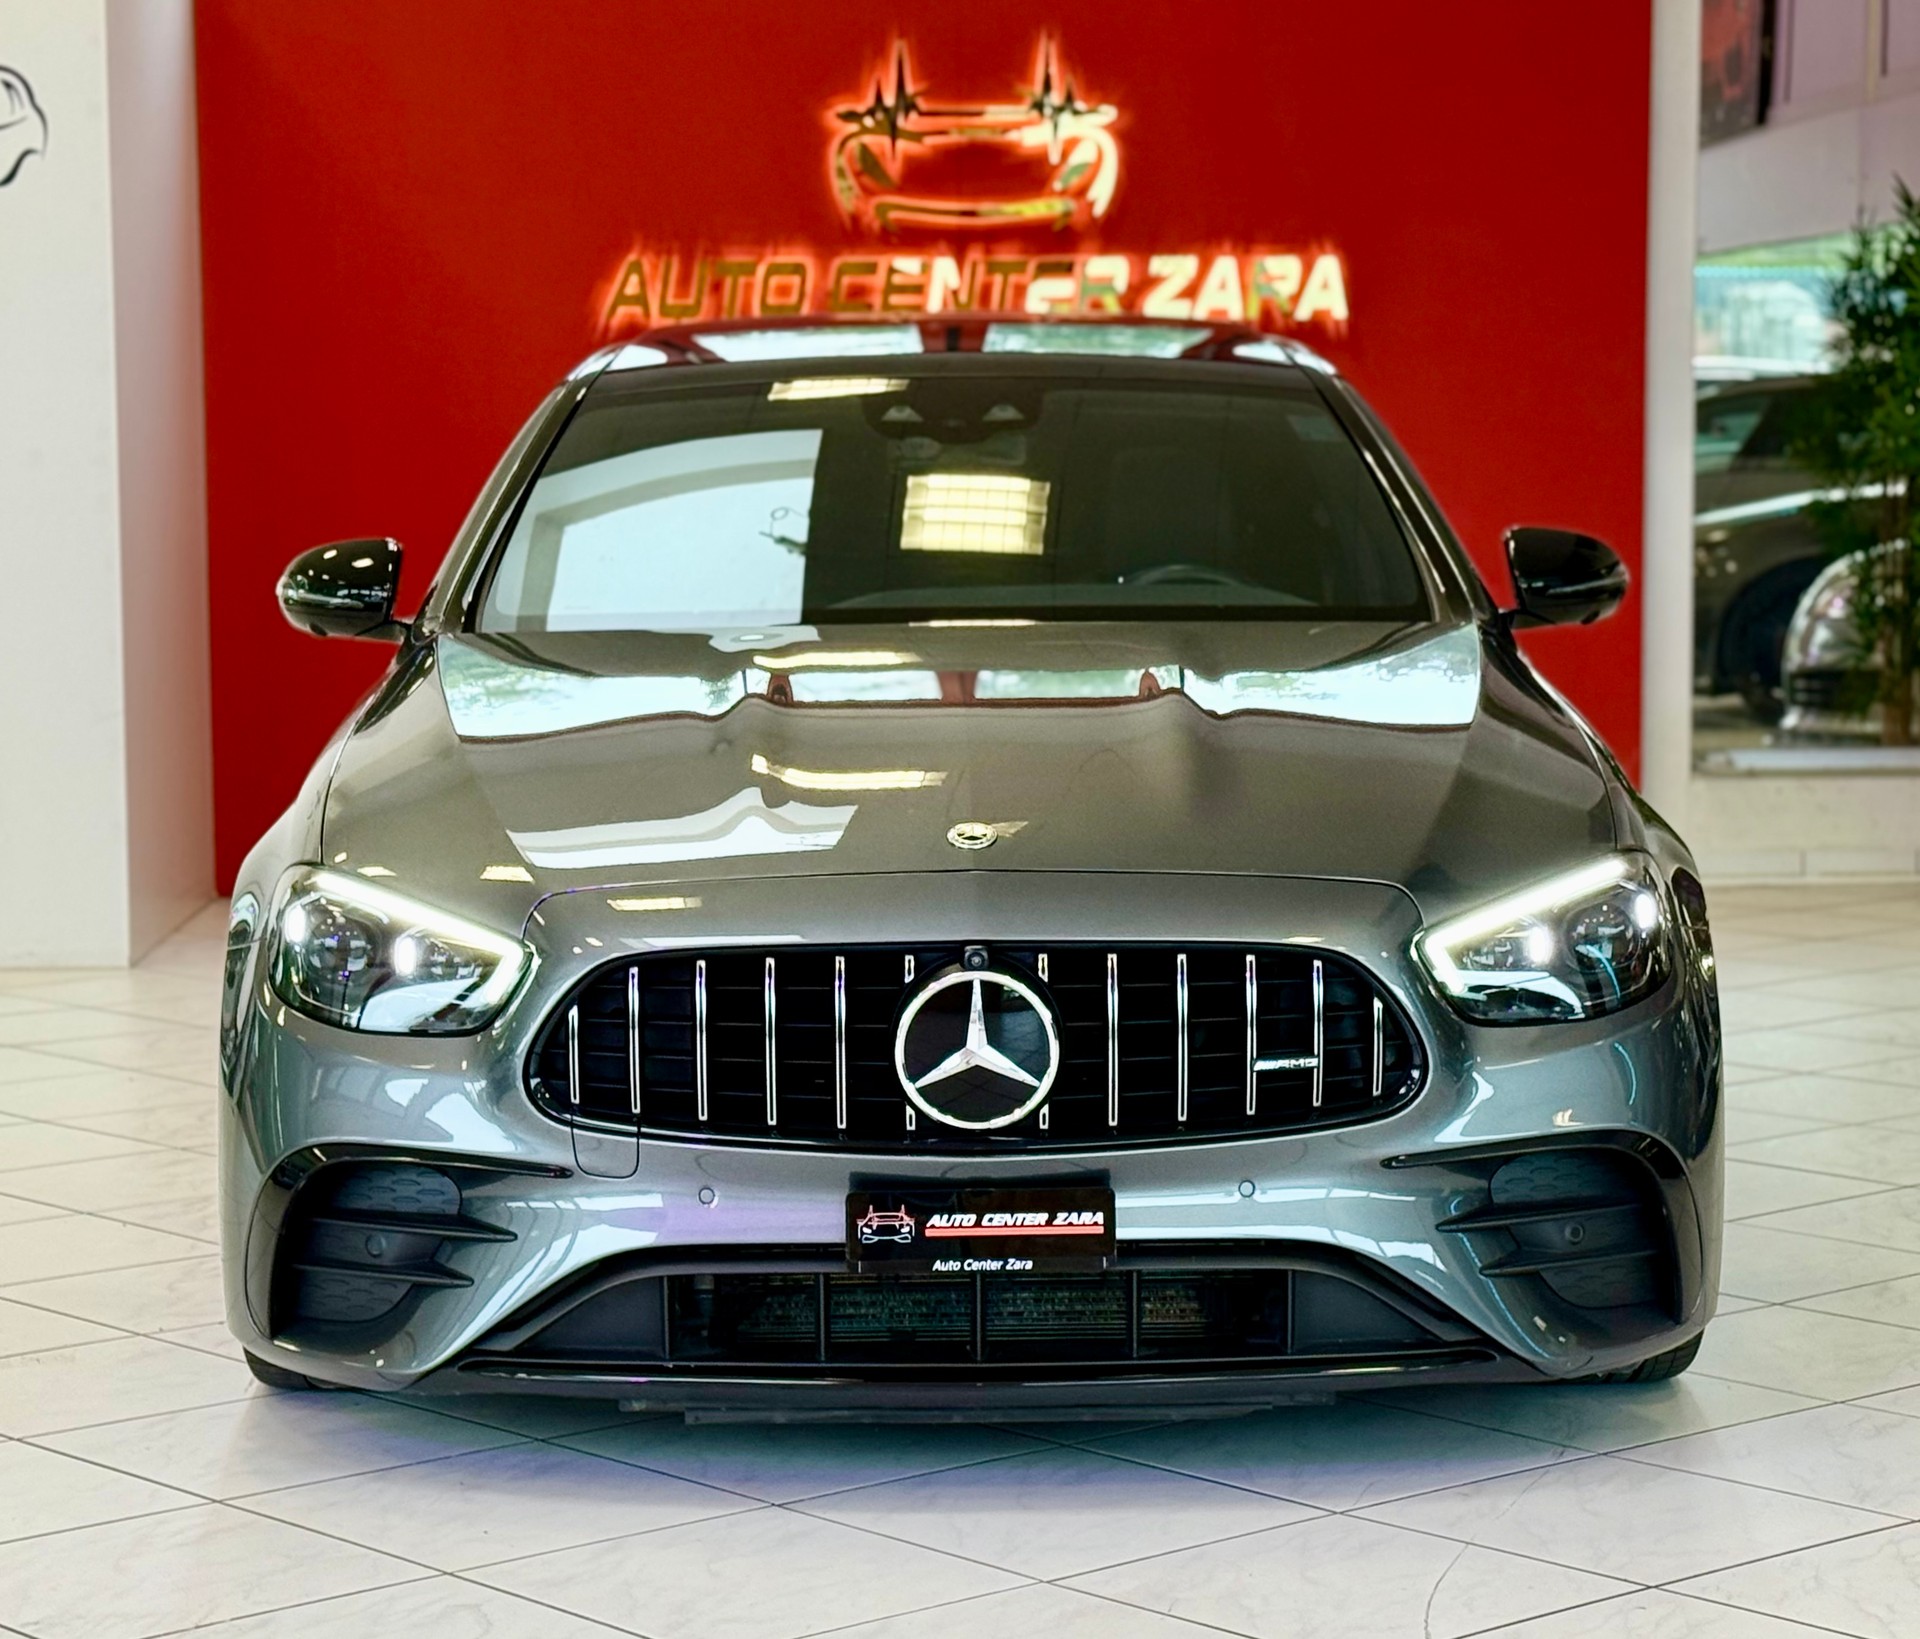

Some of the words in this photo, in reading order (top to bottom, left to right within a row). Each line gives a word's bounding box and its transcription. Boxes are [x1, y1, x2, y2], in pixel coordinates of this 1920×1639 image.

[604, 259, 806, 320] AUTO
[827, 257, 1130, 314] CENTER
[1142, 254, 1349, 321] ZARA
[926, 1213, 977, 1227] AUTO
[981, 1212, 1048, 1226] CENTER
[1052, 1211, 1104, 1225] ZARA
[932, 1259, 961, 1271] Auto
[963, 1258, 1004, 1271] Center
[1006, 1258, 1033, 1270] Zara
